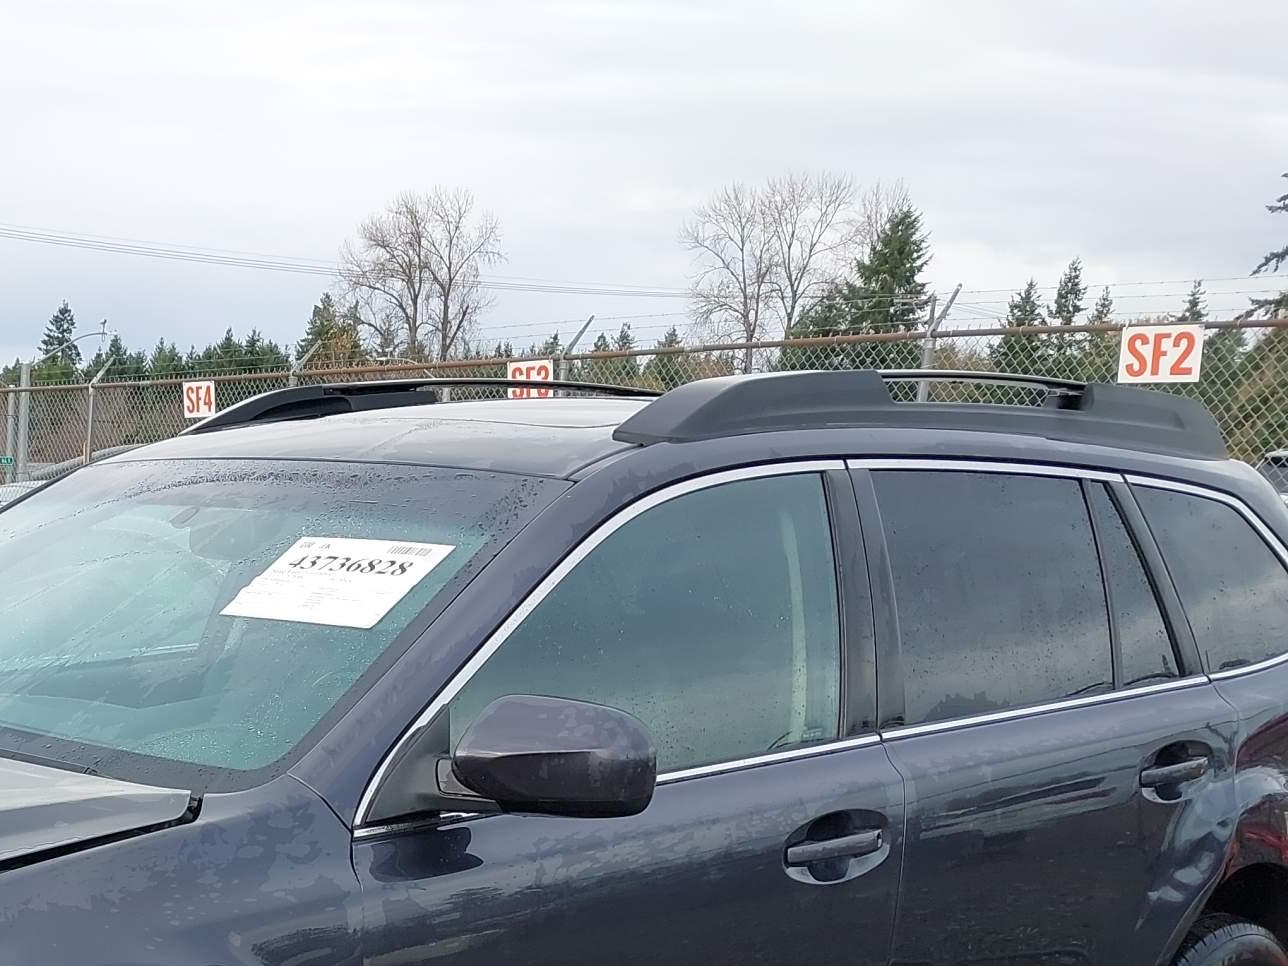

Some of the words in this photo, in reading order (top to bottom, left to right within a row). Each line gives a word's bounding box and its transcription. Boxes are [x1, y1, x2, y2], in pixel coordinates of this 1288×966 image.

[1125, 331, 1196, 378] SF2
[511, 365, 550, 399] SF3
[186, 385, 213, 414] SF4
[288, 554, 415, 577] 43736828
